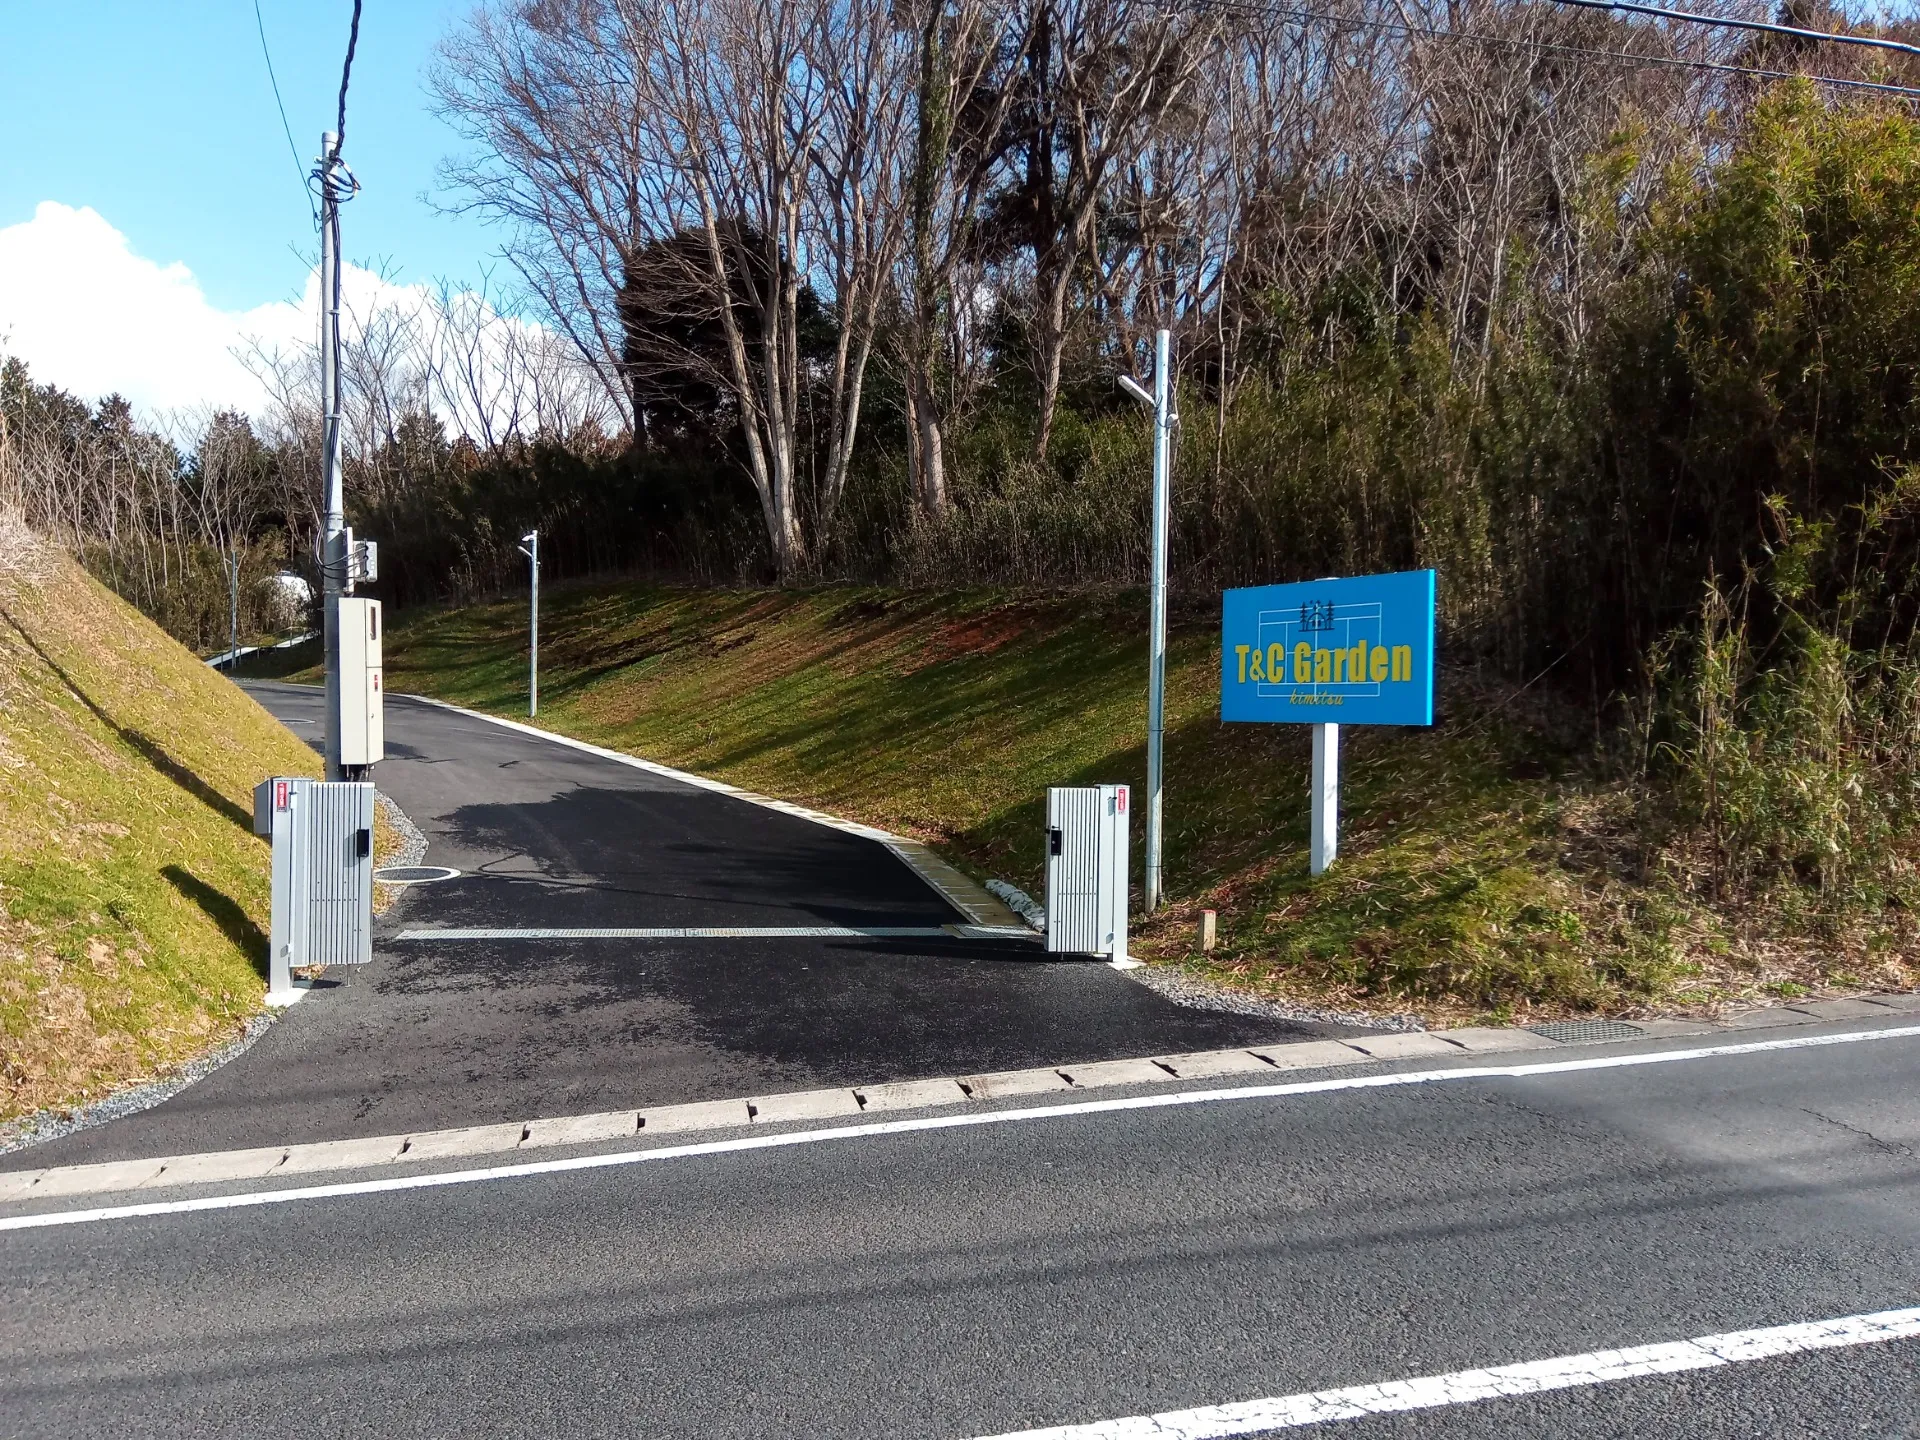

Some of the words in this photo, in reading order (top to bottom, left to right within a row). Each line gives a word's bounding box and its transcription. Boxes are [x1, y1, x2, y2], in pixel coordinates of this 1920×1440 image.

[1235, 642, 1285, 684] T&C
[1294, 639, 1412, 684] Garden
[1289, 688, 1344, 705] kimitsu
